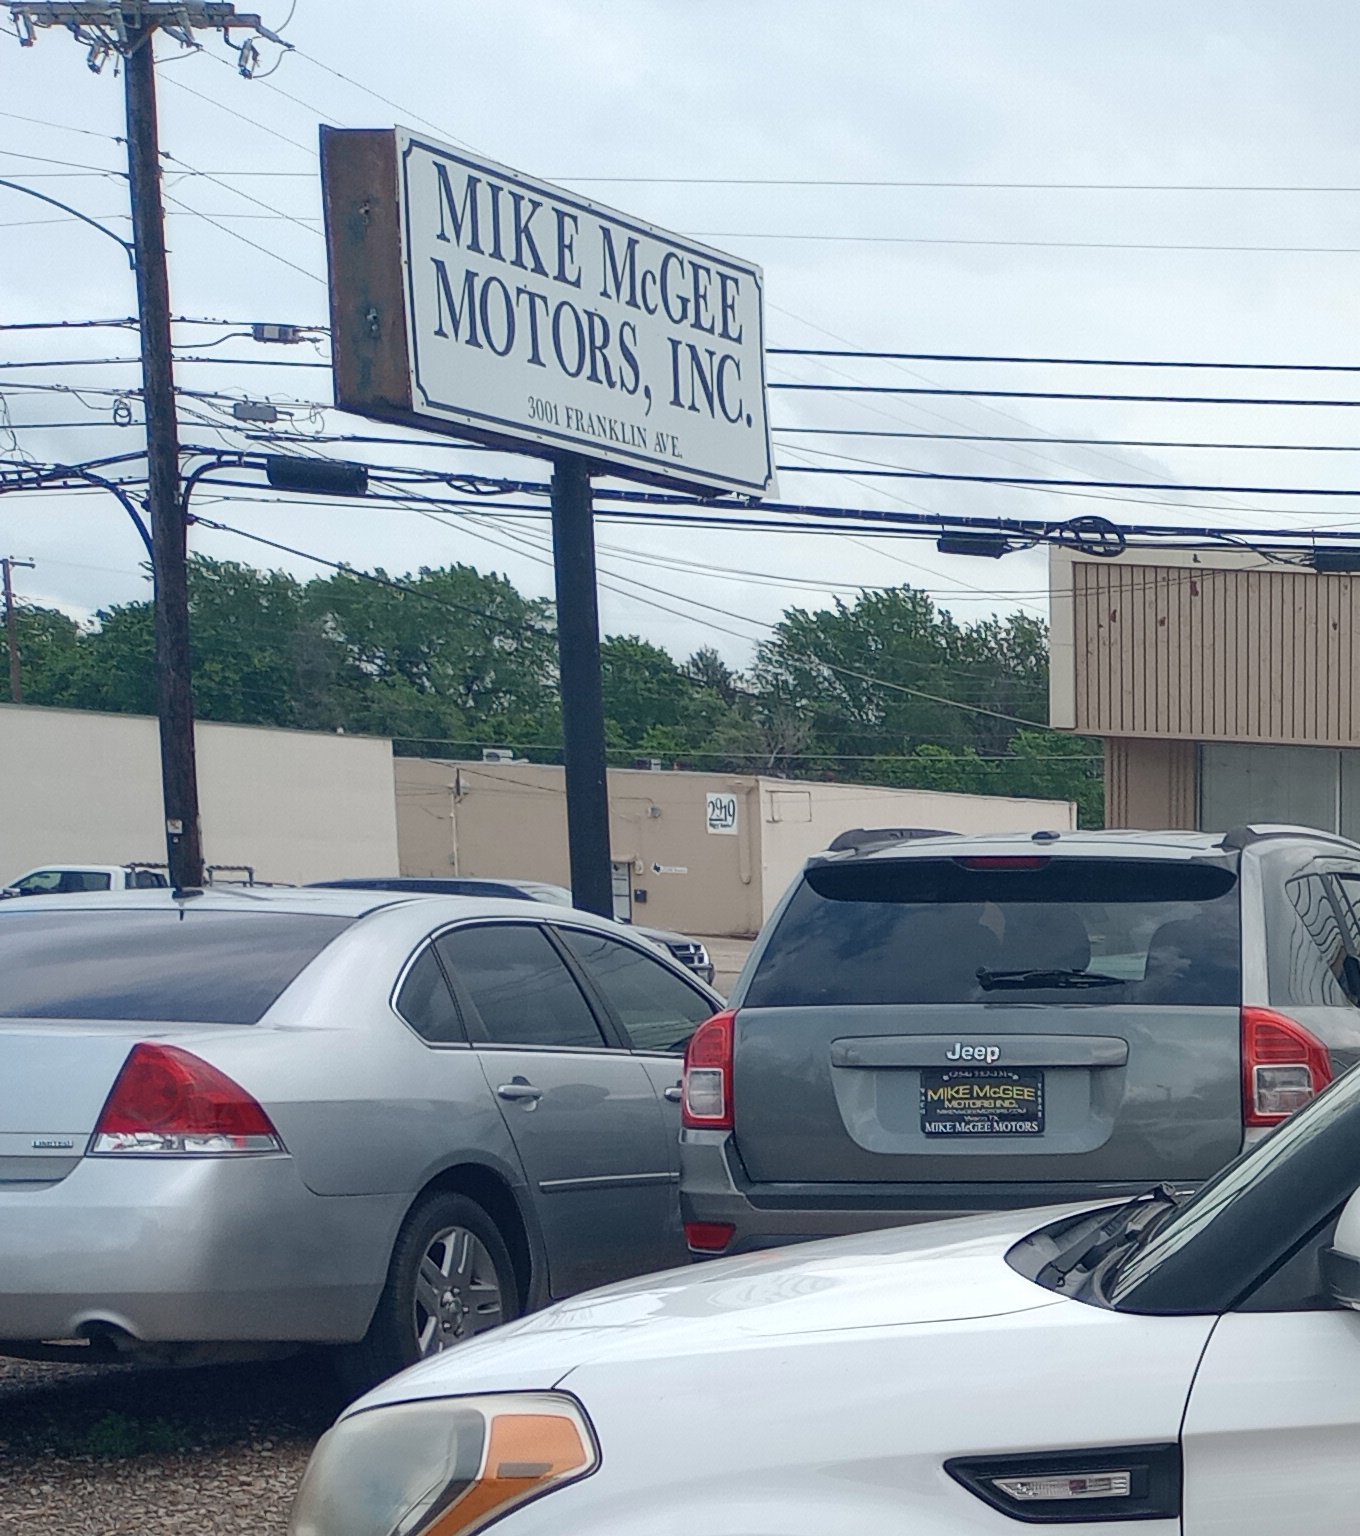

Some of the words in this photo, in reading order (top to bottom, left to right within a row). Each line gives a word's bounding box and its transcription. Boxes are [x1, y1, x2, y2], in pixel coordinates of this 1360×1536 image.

[432, 160, 582, 289] MIKE
[599, 224, 743, 345] McGEE
[430, 257, 652, 416] MOTORS,
[667, 336, 753, 428] INC.
[528, 396, 560, 426] 3001
[565, 406, 647, 449] FRANKLIN
[654, 432, 683, 459] AVE.
[946, 1042, 1000, 1064] Jeep
[927, 1085, 971, 1101] MIKE
[973, 1085, 1035, 1100] McGEE
[925, 1122, 954, 1133] MIKE
[956, 1122, 992, 1133] McGEE
[993, 1121, 1039, 1132] MOTORS
